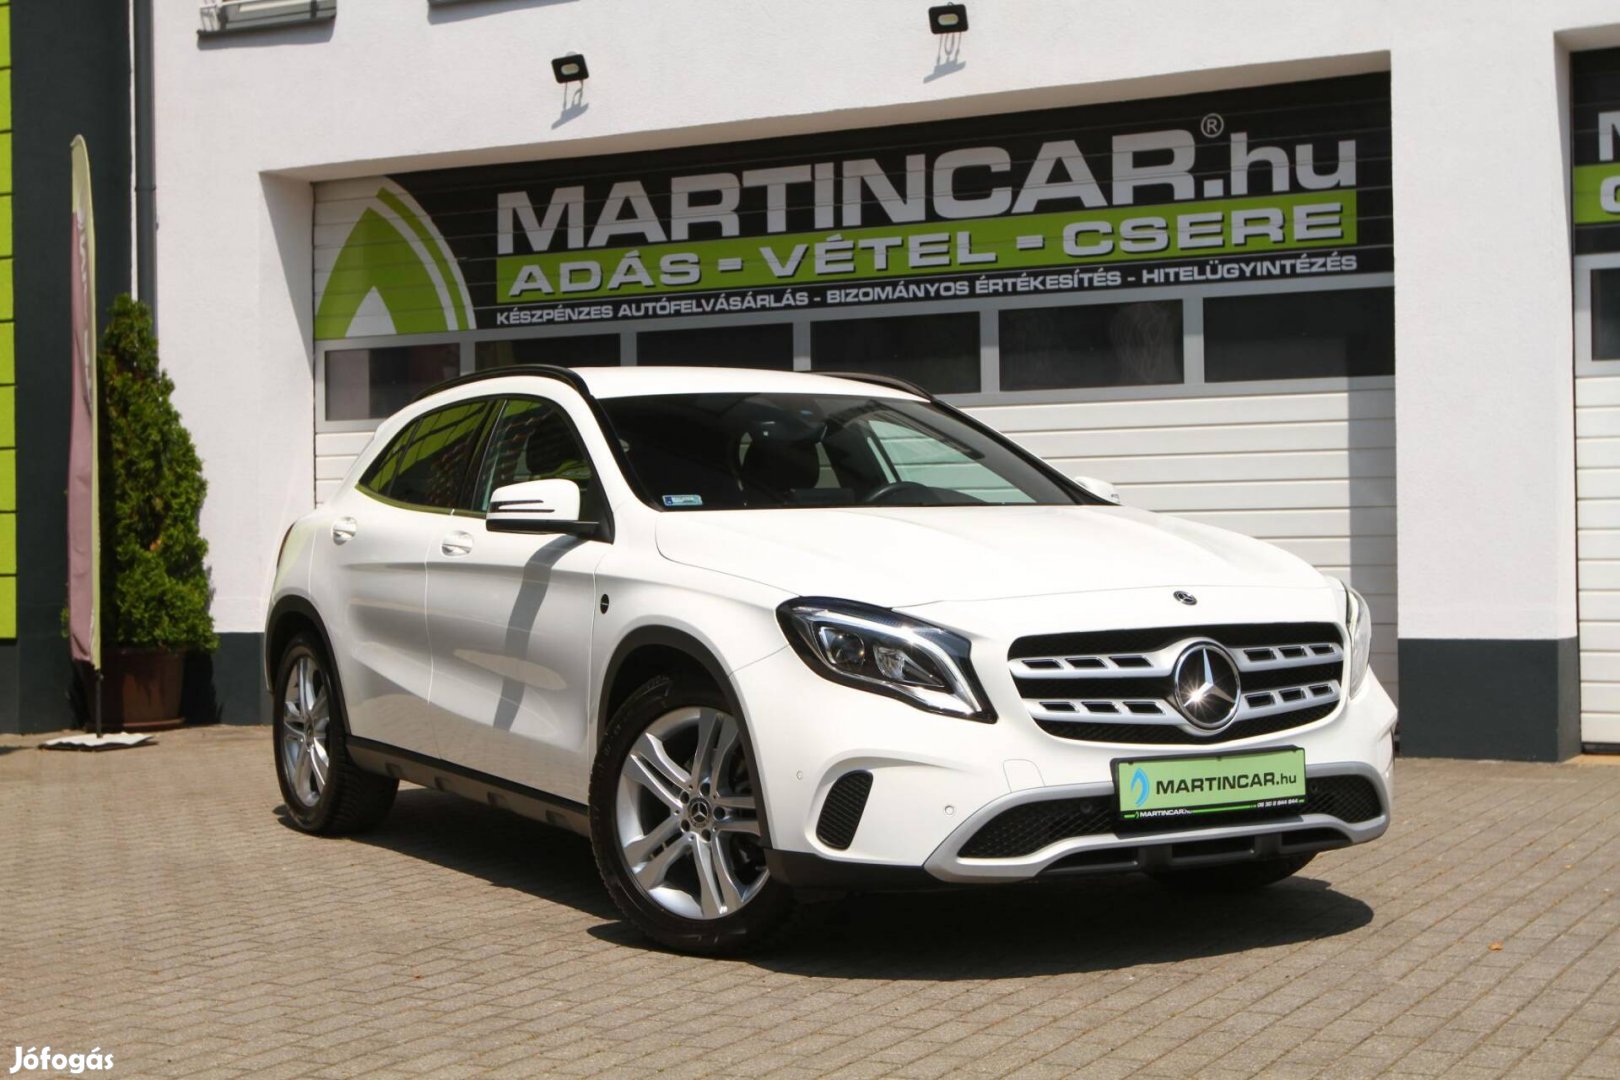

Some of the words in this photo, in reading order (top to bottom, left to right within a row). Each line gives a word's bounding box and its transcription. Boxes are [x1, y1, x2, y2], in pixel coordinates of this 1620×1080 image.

[508, 250, 701, 297] ADÁS
[759, 231, 998, 279] VÉTEL
[1062, 202, 1344, 258] CSERE
[496, 304, 614, 326] KÉSZPÉNZES
[618, 290, 810, 318] AUTÓFELVÁSÁRLÁS
[826, 279, 970, 305] BIZOMÁNYOS
[975, 268, 1122, 295] ÉRTÉKESÍTÉS
[1142, 252, 1358, 284] HITELÜGYINTÉZÉS
[1156, 772, 1297, 795] MARTINCAR.hu
